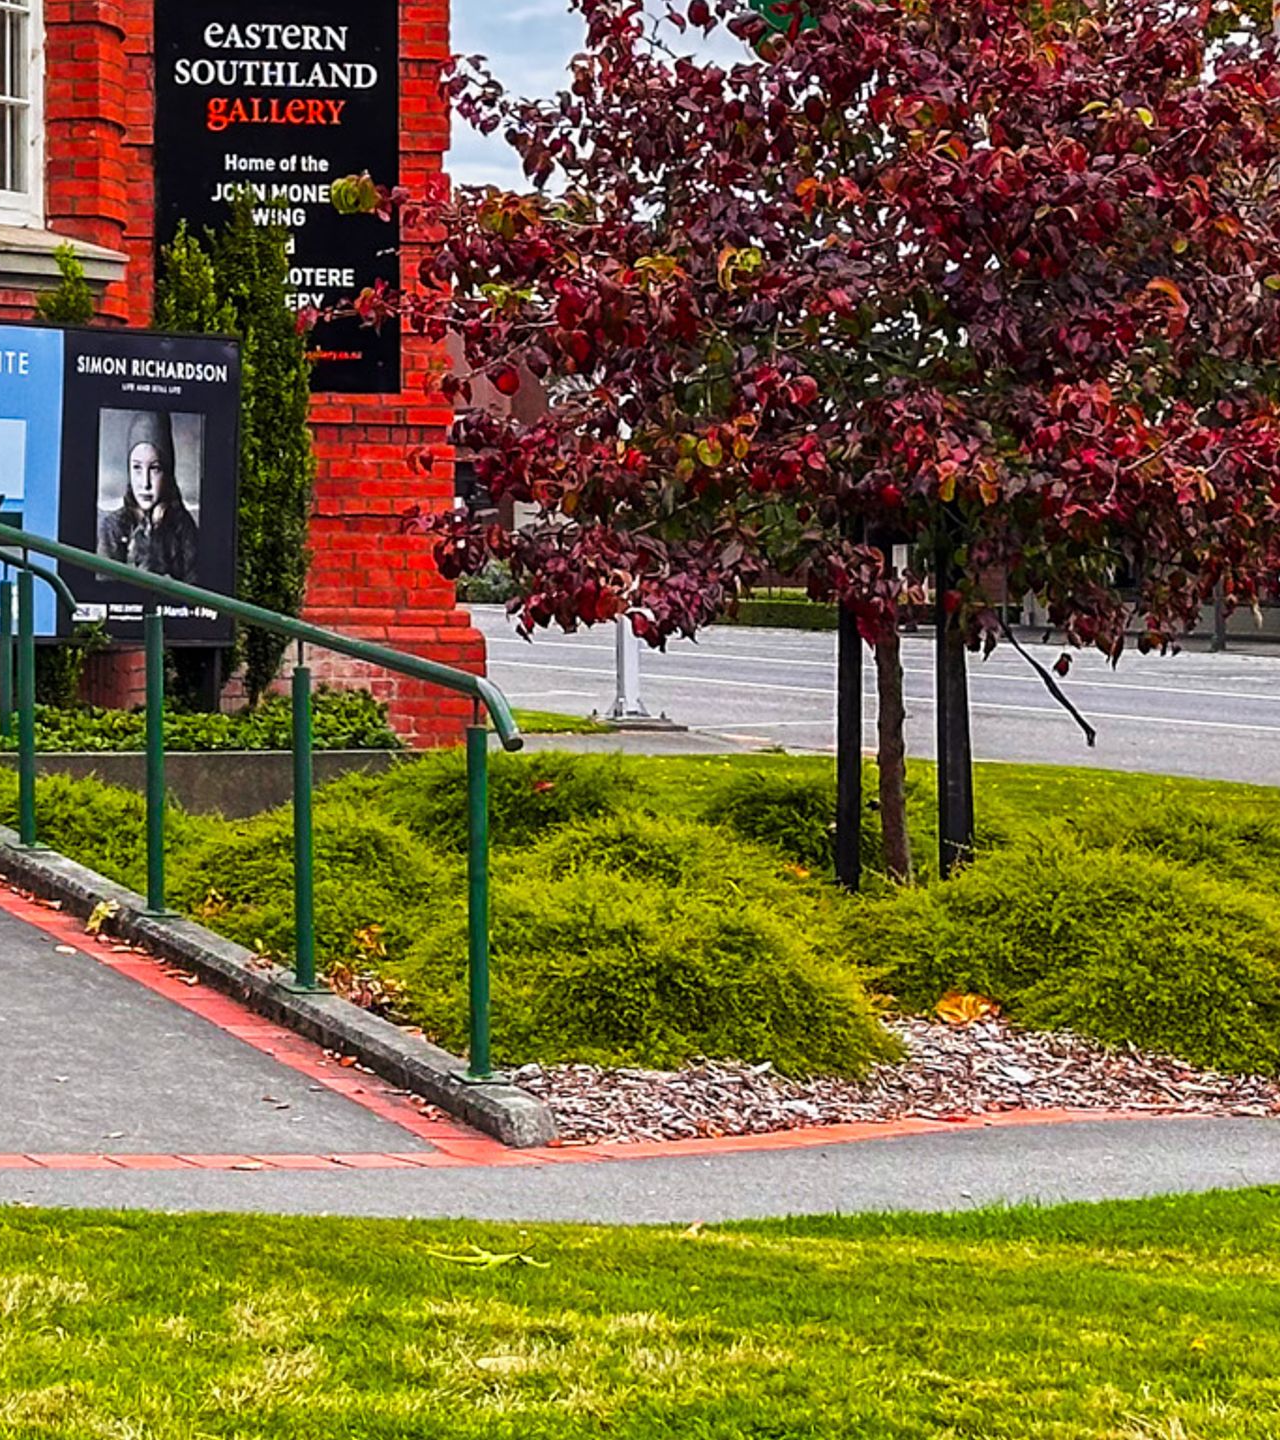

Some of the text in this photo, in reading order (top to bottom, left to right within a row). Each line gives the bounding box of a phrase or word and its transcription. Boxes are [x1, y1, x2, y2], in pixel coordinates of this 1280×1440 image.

[174, 60, 378, 89] SOUTHLAND
[225, 154, 329, 172] Home of the
[281, 267, 355, 287] OTERE
[77, 355, 227, 382] SIMON RICHARDSON
